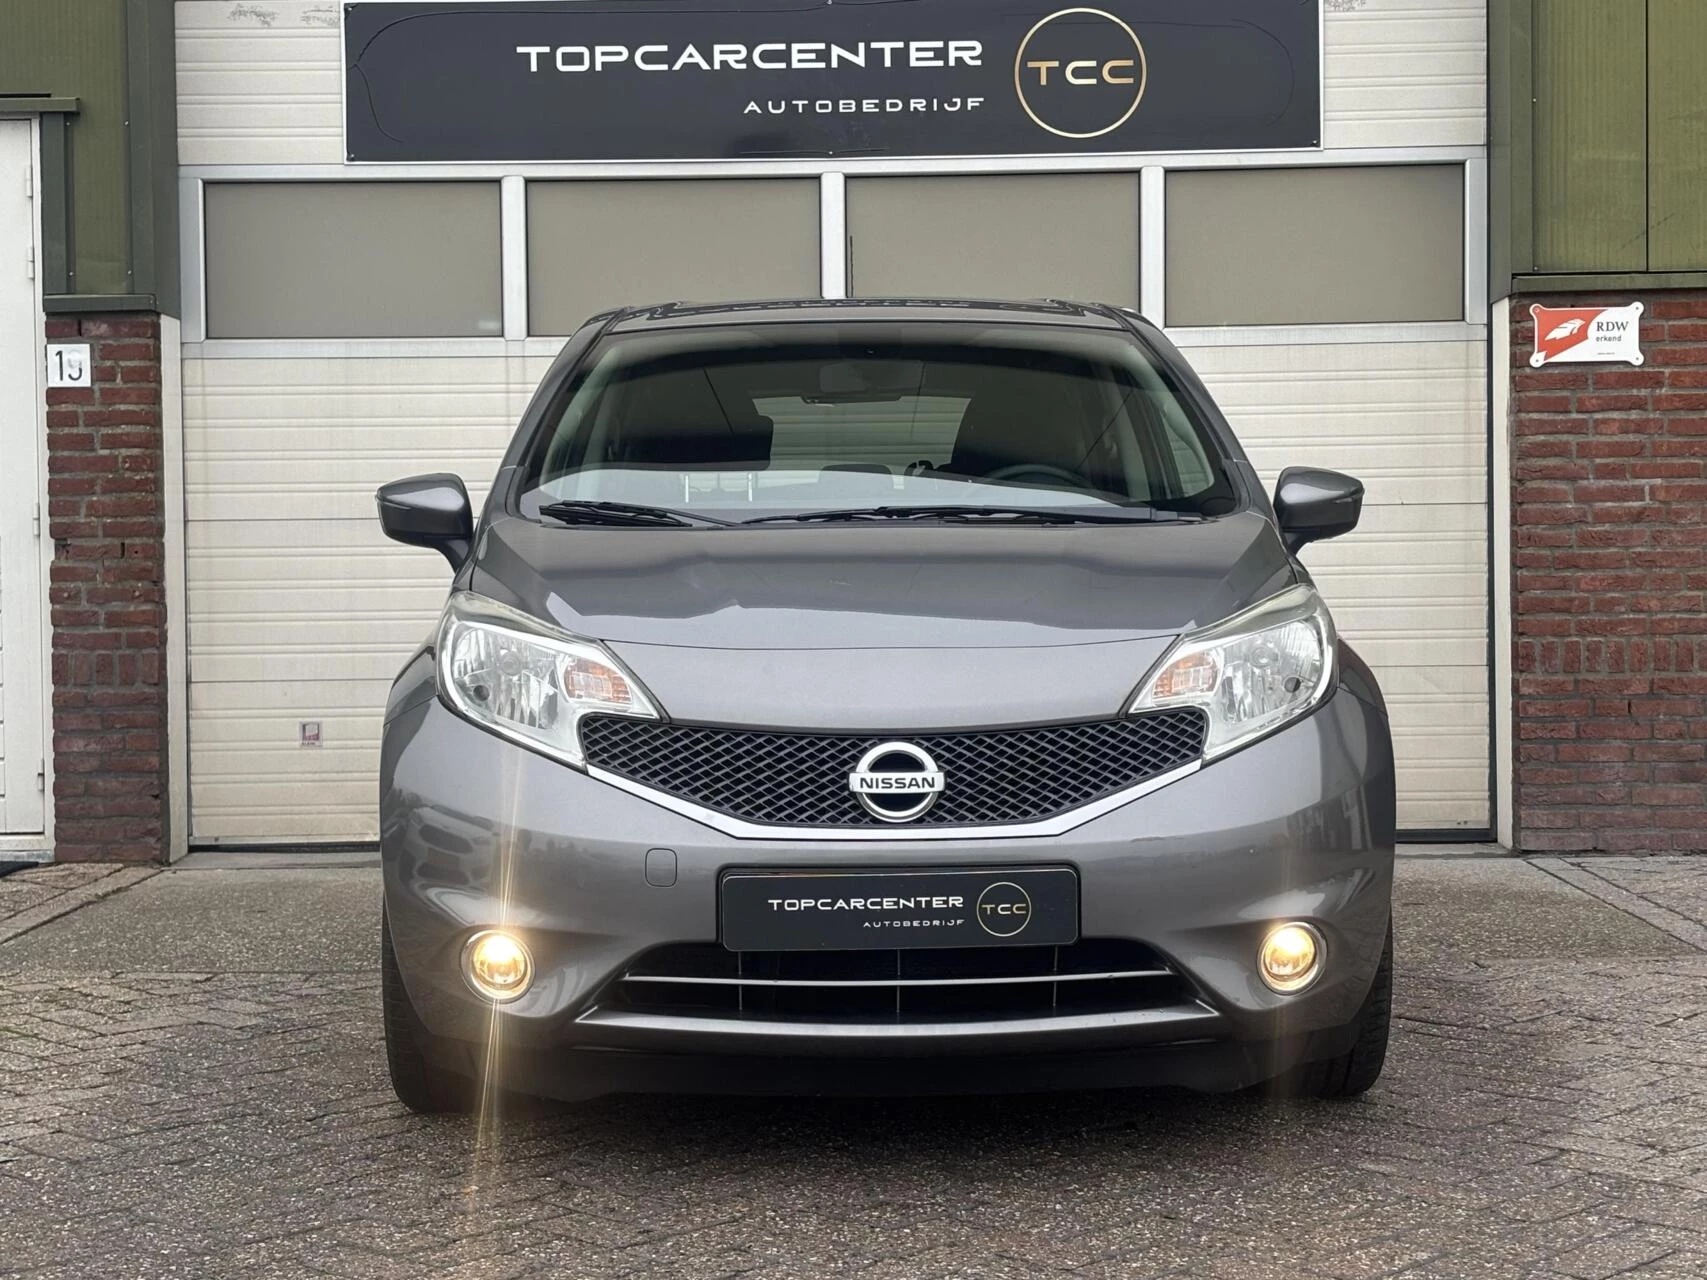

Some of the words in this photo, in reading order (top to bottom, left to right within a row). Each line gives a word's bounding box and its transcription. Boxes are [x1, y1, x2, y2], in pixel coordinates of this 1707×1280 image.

[516, 40, 983, 73] TOPCARCENTER
[1027, 59, 1135, 86] TCC
[743, 97, 985, 114] AUTOBEDRIJF
[1596, 321, 1629, 332] RDW
[859, 776, 935, 790] NISSAN
[768, 896, 964, 911] TOPCARCENTER
[982, 903, 1027, 915] TCC
[863, 919, 965, 928] AUTOBEDRIJF
